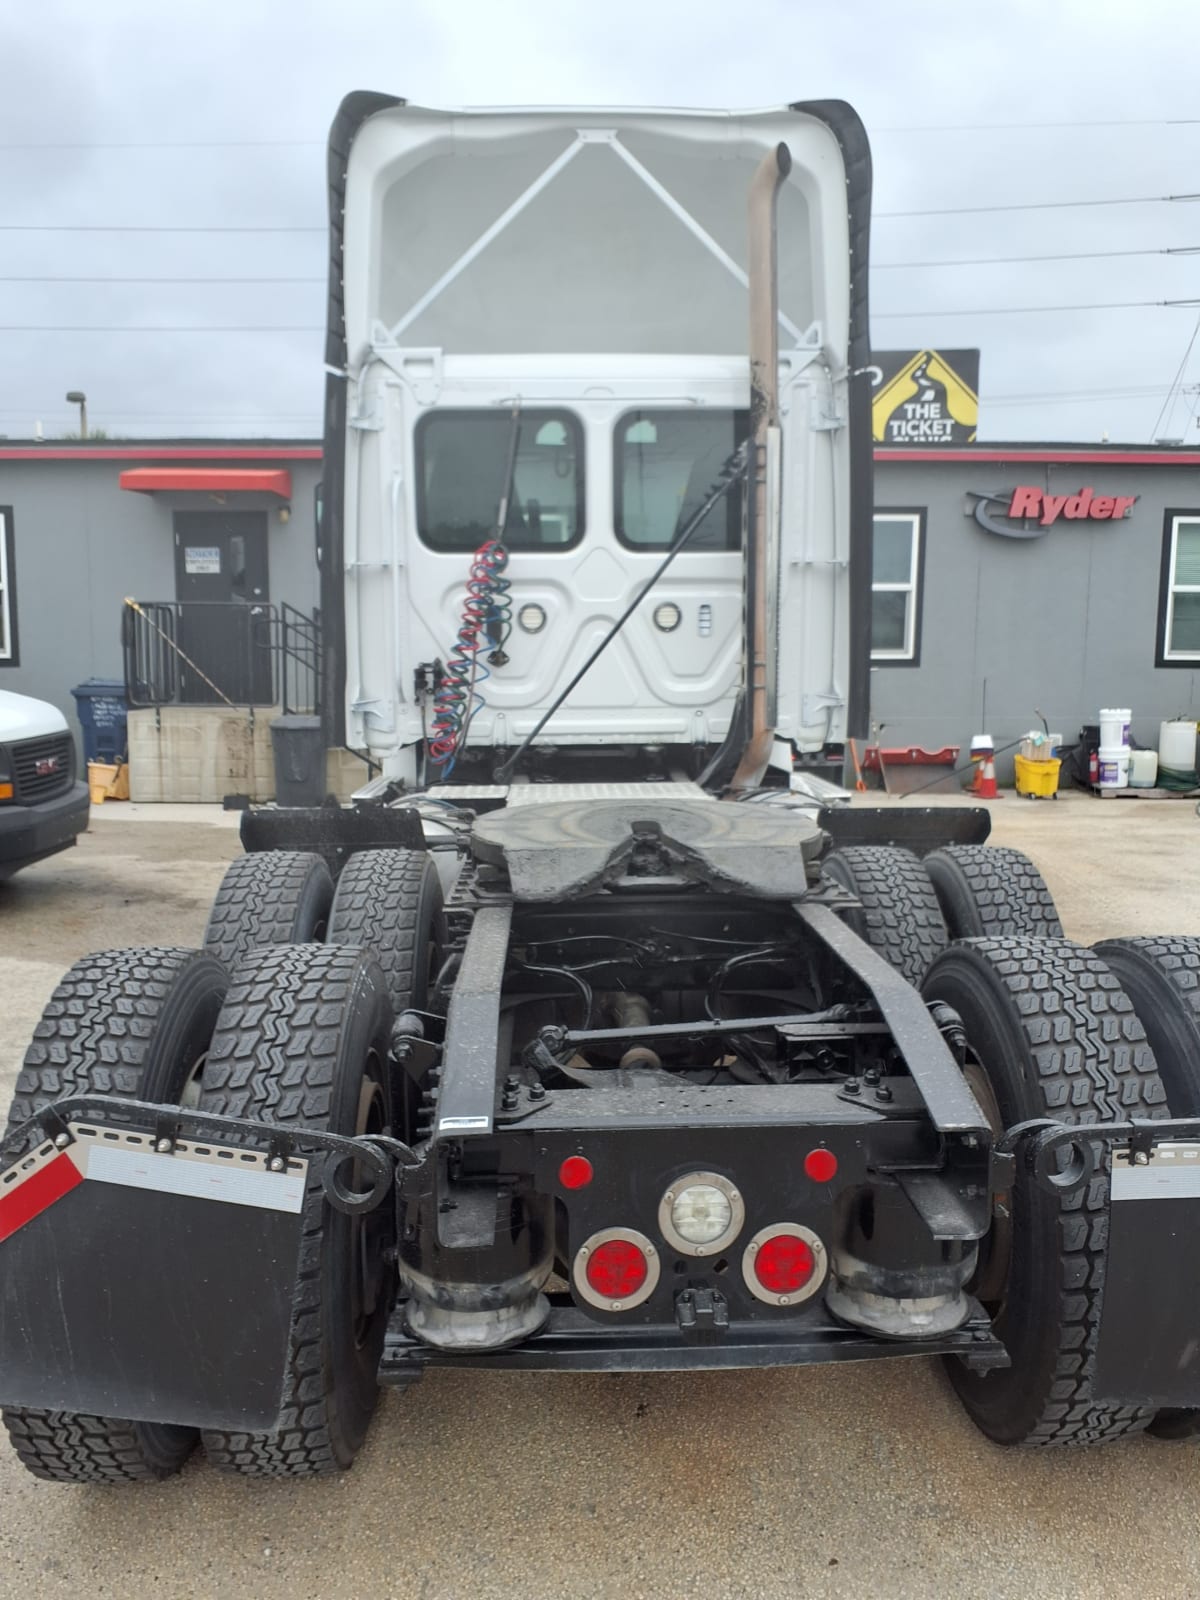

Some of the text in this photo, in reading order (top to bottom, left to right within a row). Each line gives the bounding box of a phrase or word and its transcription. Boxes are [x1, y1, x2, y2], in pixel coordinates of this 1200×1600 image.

[904, 403, 941, 419] THE
[889, 420, 955, 436] TICKET
[1009, 486, 1135, 525] Ryder
